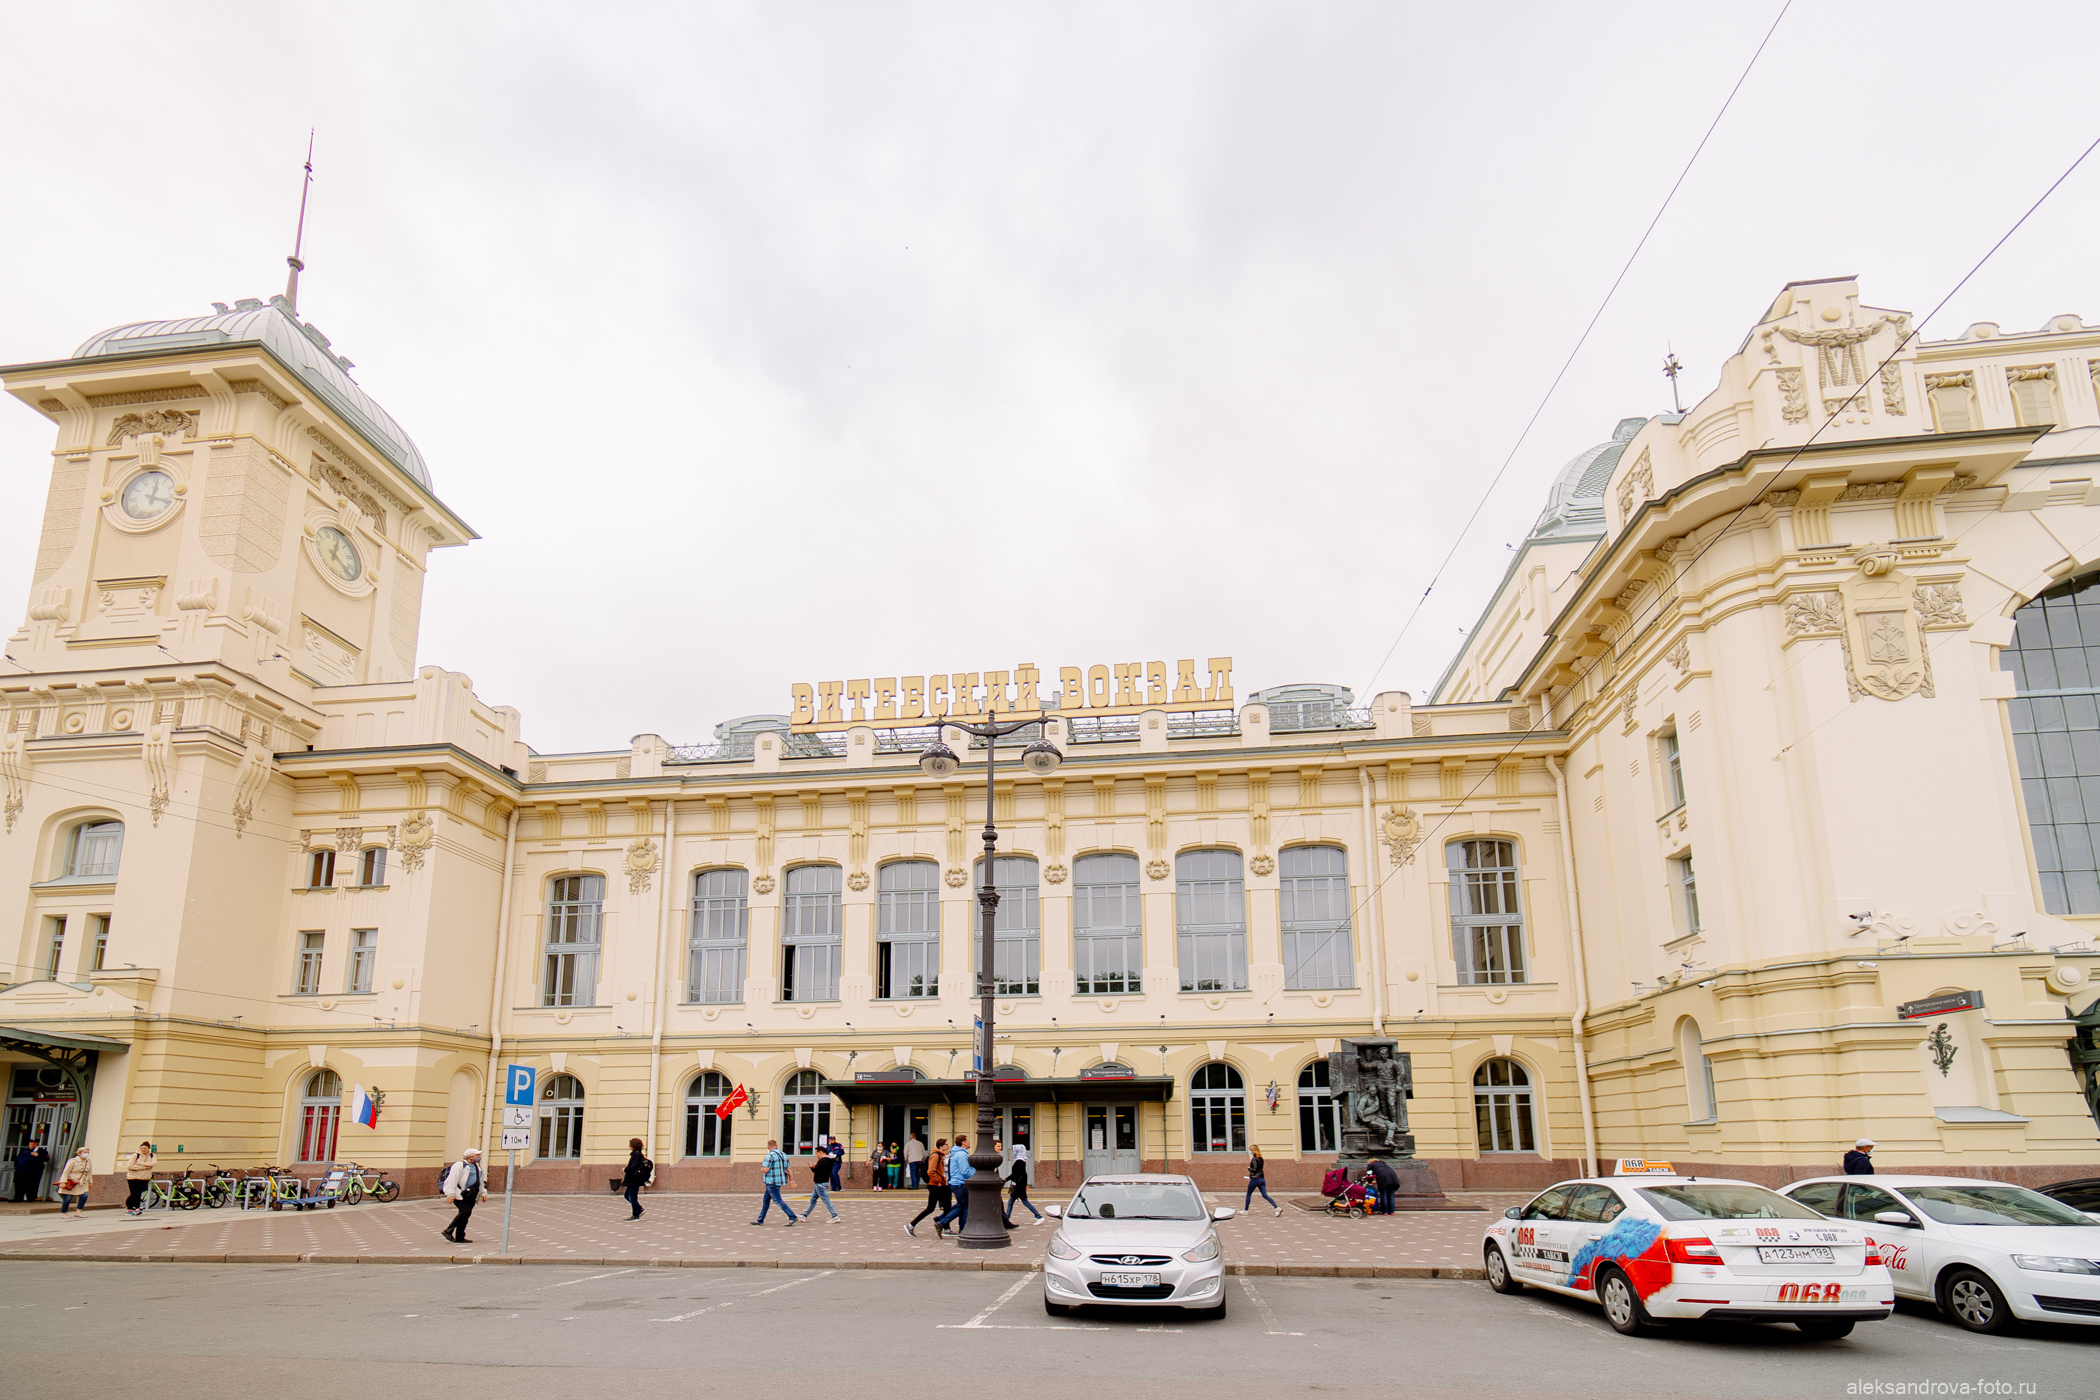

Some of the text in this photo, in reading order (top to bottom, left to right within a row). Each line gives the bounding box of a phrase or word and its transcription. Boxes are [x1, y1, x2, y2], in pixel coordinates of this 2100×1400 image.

[791, 656, 1234, 725] ВИТЕБСКИЙ ВОКЗАЛ
[513, 1069, 531, 1101] P
[1625, 1159, 1644, 1168] 068
[1518, 1227, 1534, 1245] 068
[1755, 1227, 1780, 1237] 068
[1822, 1233, 1838, 1242] 068
[1543, 1250, 1563, 1261] ТАКСИ
[1812, 1247, 1830, 1257] 198
[1777, 1282, 1842, 1303] 068
[1841, 1290, 1867, 1300] 068
